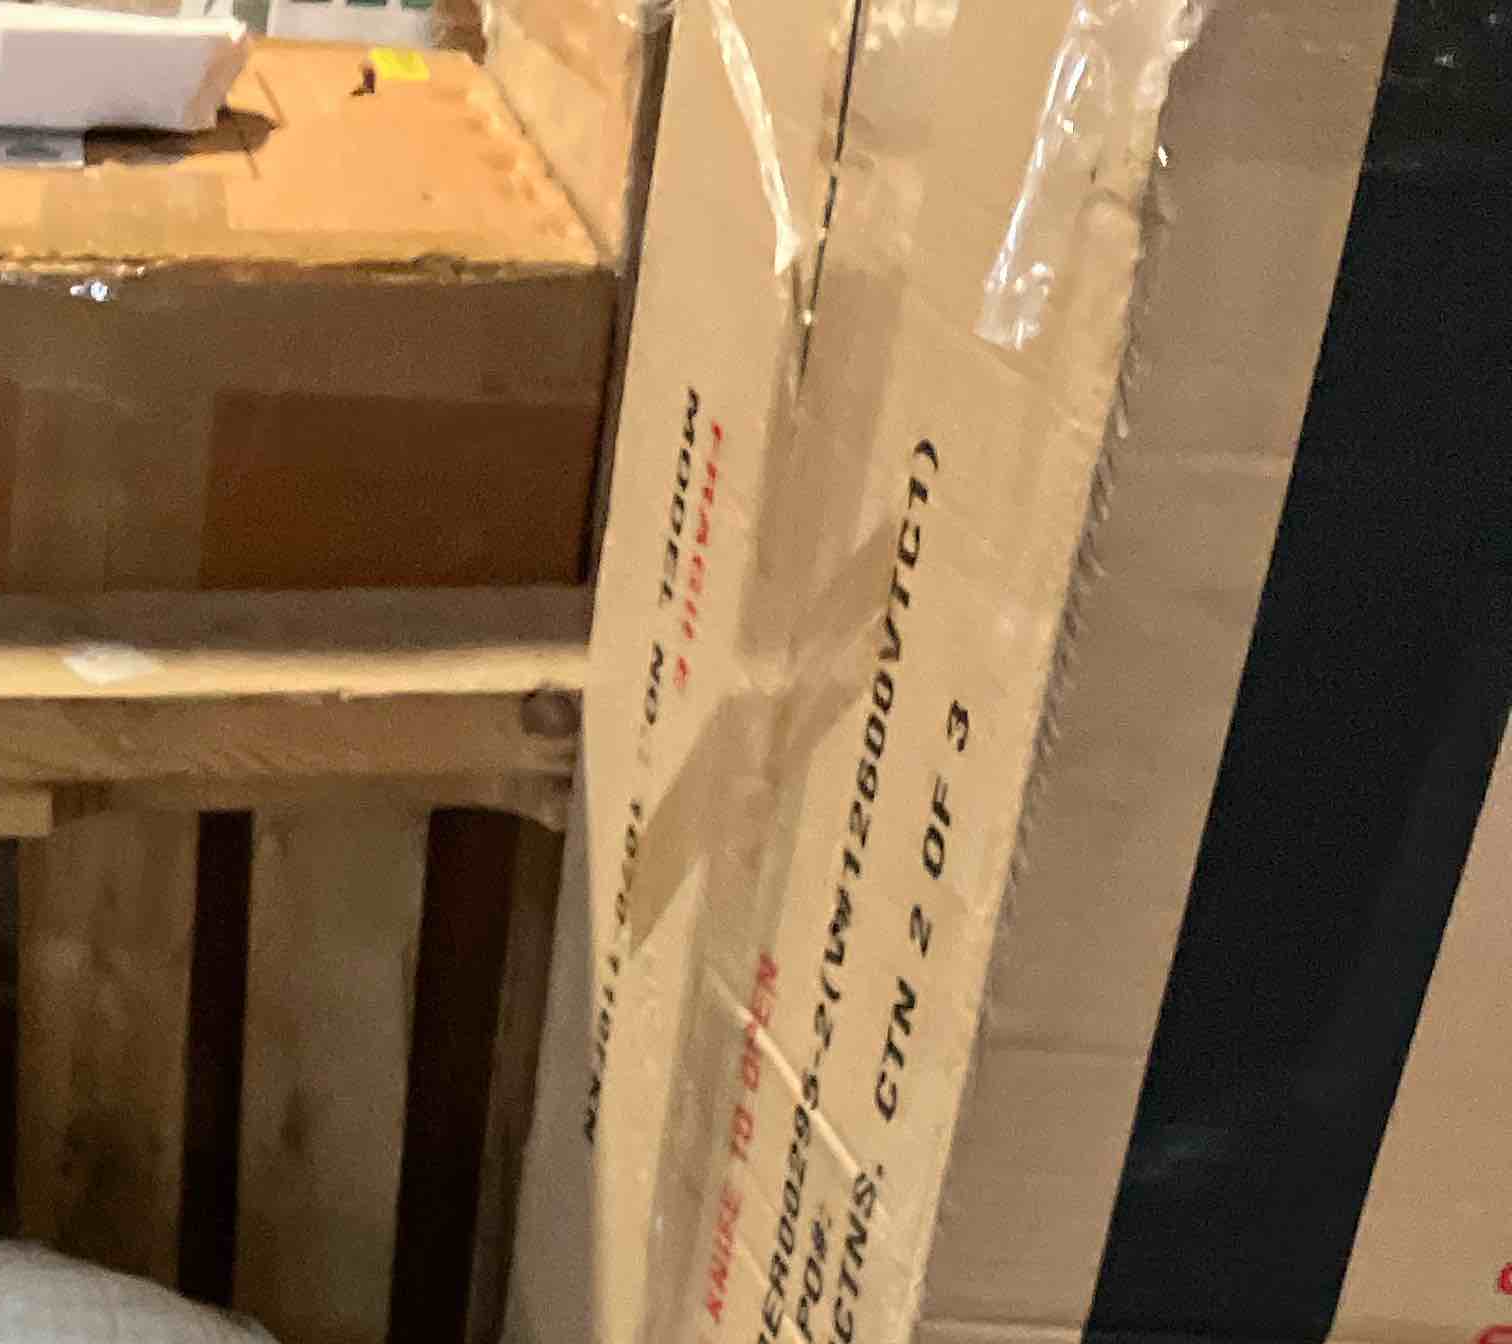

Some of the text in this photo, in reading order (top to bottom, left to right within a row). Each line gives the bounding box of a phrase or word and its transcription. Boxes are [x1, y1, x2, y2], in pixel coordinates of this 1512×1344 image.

[657, 386, 700, 608] MODEL
[874, 975, 917, 1122] CTN
[909, 903, 932, 956] 2
[921, 774, 950, 878] OF
[946, 699, 969, 752] 3
[740, 947, 778, 1091] OPEN
[728, 1103, 754, 1162] TO
[705, 1185, 742, 1324] KNIFE
[796, 1201, 832, 1344] PO#:
